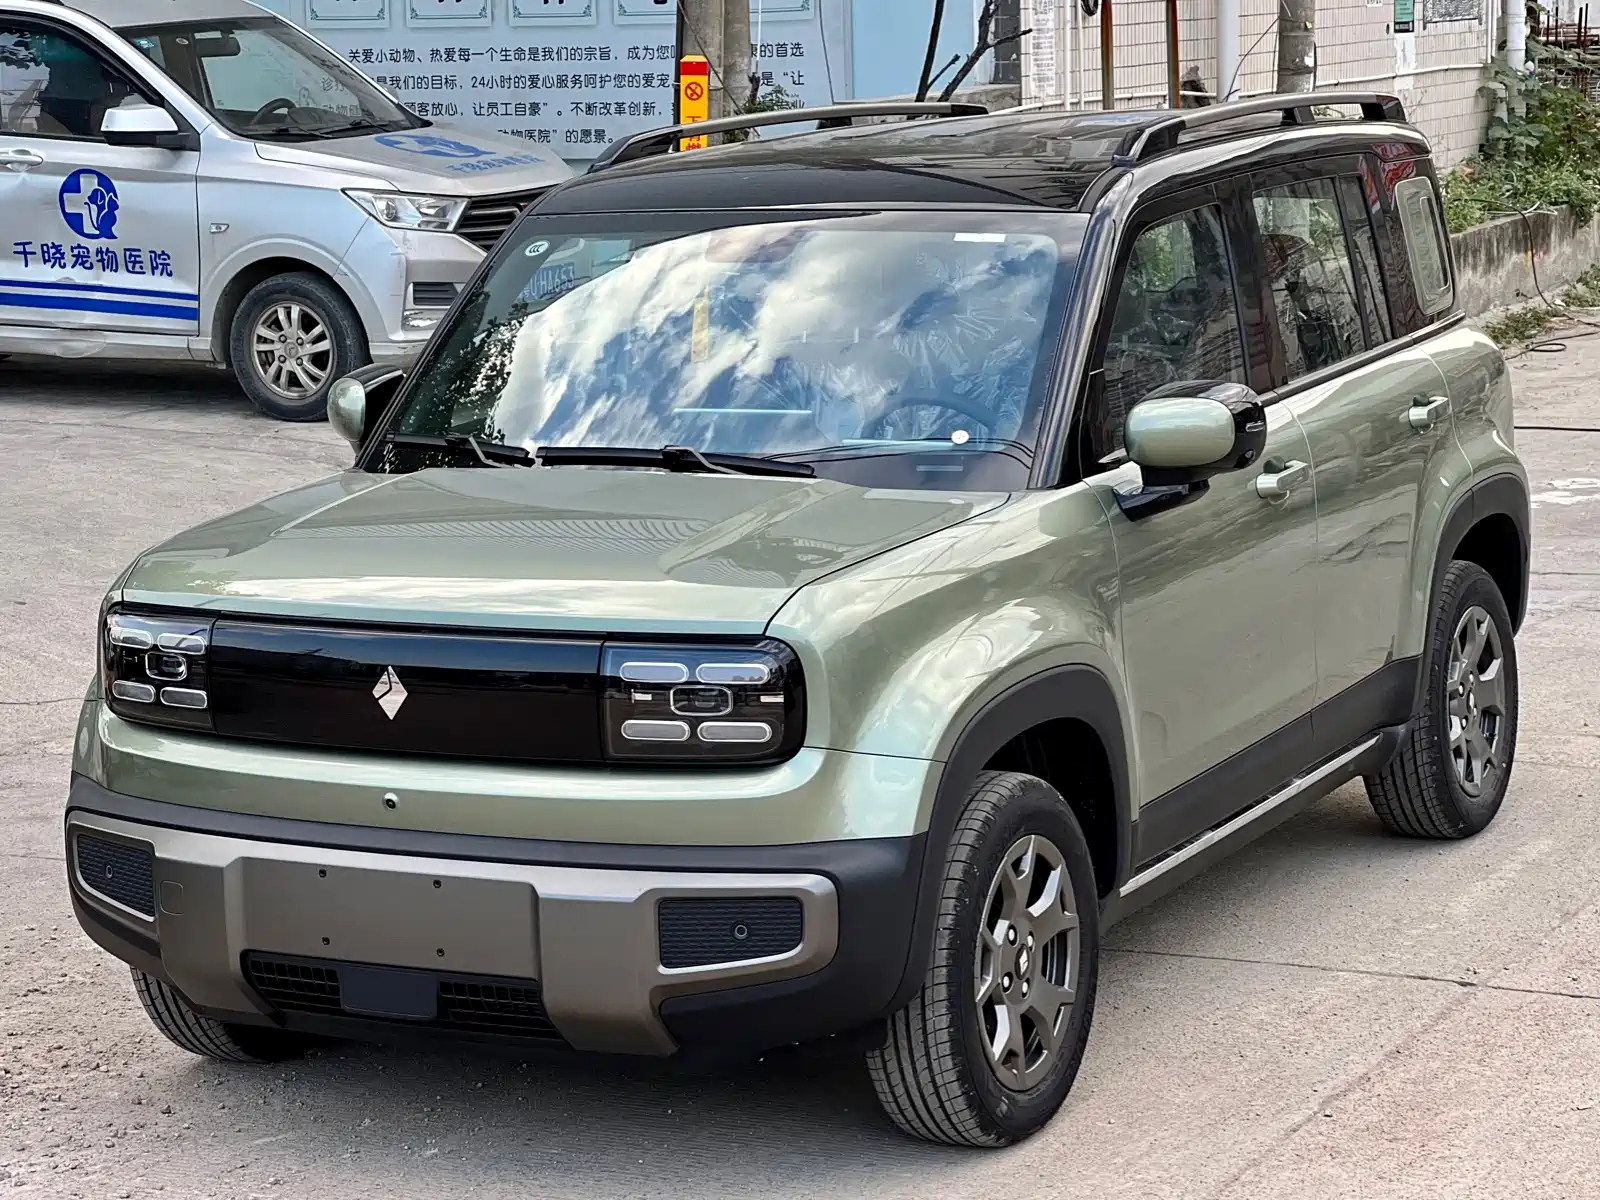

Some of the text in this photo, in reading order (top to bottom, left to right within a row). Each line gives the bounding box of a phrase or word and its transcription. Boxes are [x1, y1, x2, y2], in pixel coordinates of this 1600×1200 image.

[404, 101, 675, 117] 客放心，让员工自豪”。不断改革创新，
[13, 240, 174, 277] 千晓宠物医院
